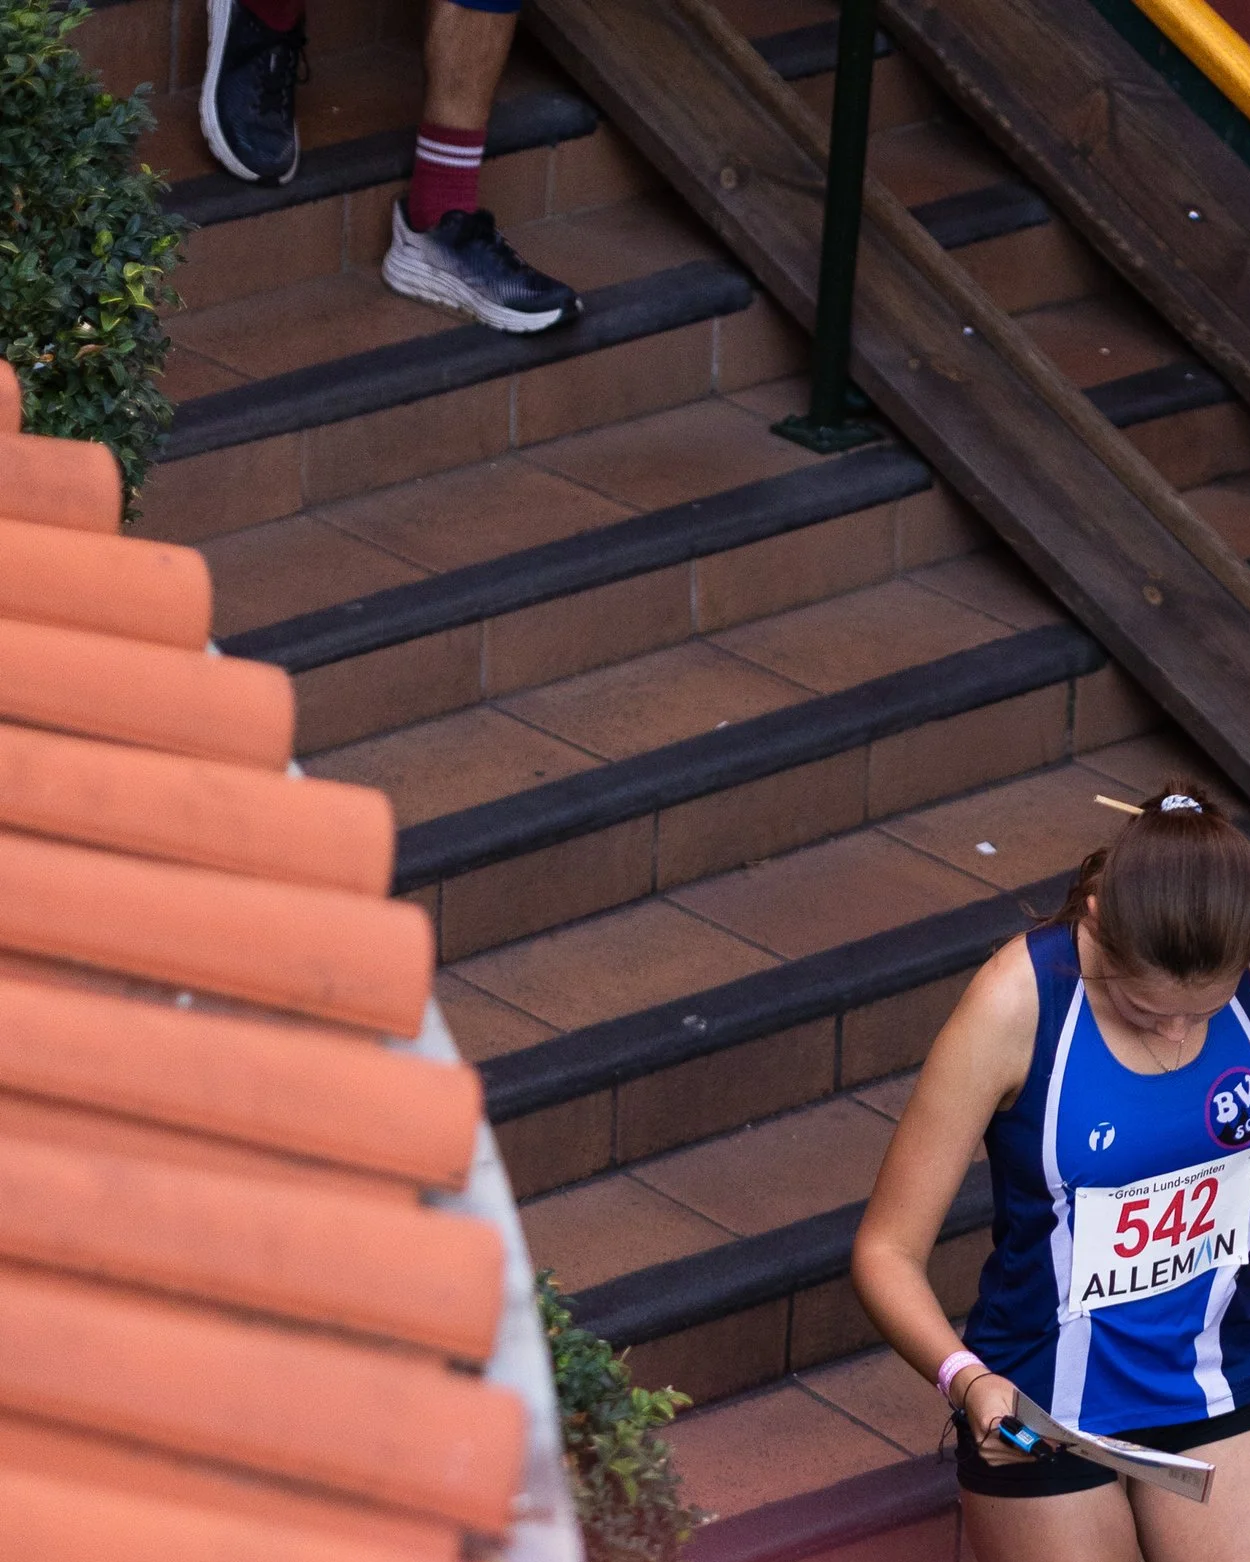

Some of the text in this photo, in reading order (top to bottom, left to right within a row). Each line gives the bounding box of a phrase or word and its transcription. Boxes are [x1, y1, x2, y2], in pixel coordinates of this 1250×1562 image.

[1153, 1164, 1226, 1192] Lund-sprinten
[1113, 1177, 1218, 1258] 542
[1082, 1229, 1236, 1301] ALLEMAN
